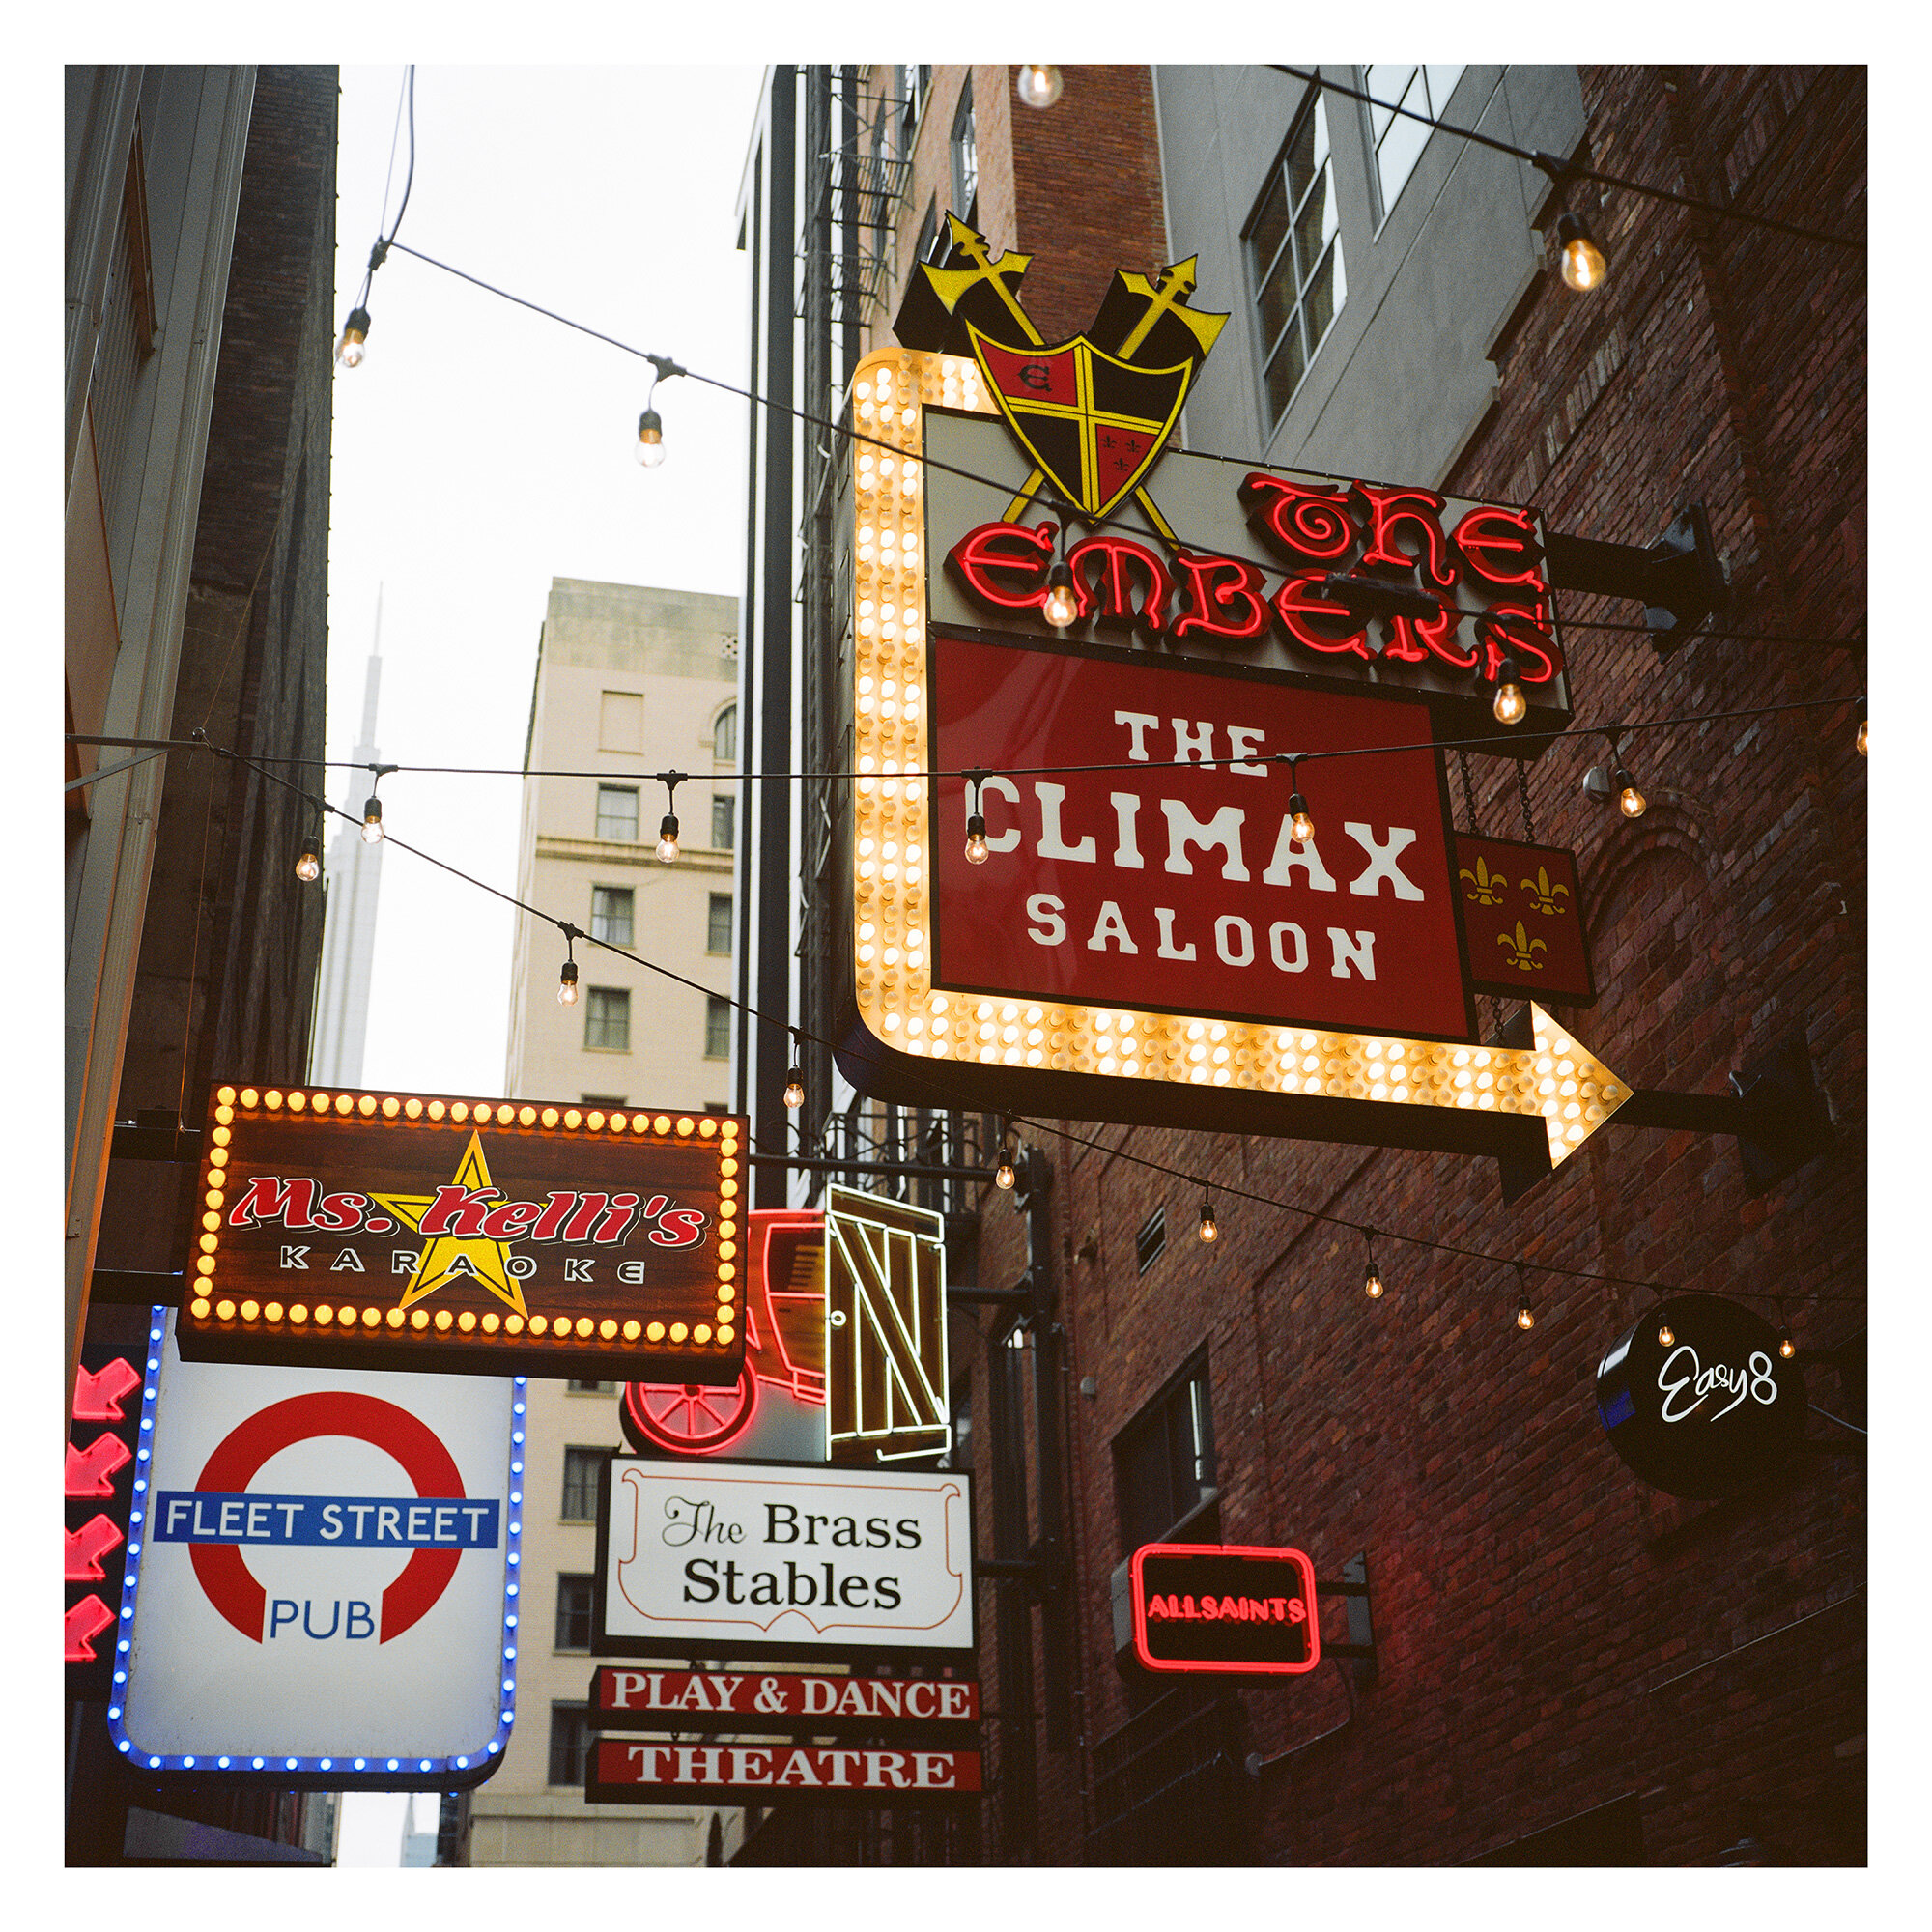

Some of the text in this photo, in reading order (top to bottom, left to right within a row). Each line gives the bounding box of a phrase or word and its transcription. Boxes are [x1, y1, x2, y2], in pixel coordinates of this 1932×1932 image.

[1239, 472, 1553, 592] THE
[946, 519, 1563, 685] EMBERS
[1114, 710, 1268, 777] THE
[965, 776, 1426, 902] CLIMAX
[1026, 893, 1378, 981] SALOON
[228, 1176, 714, 1251] Ms. Kelli's
[279, 1244, 646, 1285] KARAOKE
[165, 1499, 490, 1543] FLEET STREET
[661, 1494, 923, 1550] The Brass
[683, 1557, 903, 1610] Stables
[1148, 1593, 1307, 1626] ALLSAINTS
[269, 1599, 376, 1641] PUB
[611, 1671, 972, 1719] PLAY & DANCE
[627, 1745, 956, 1790] THEATRE
